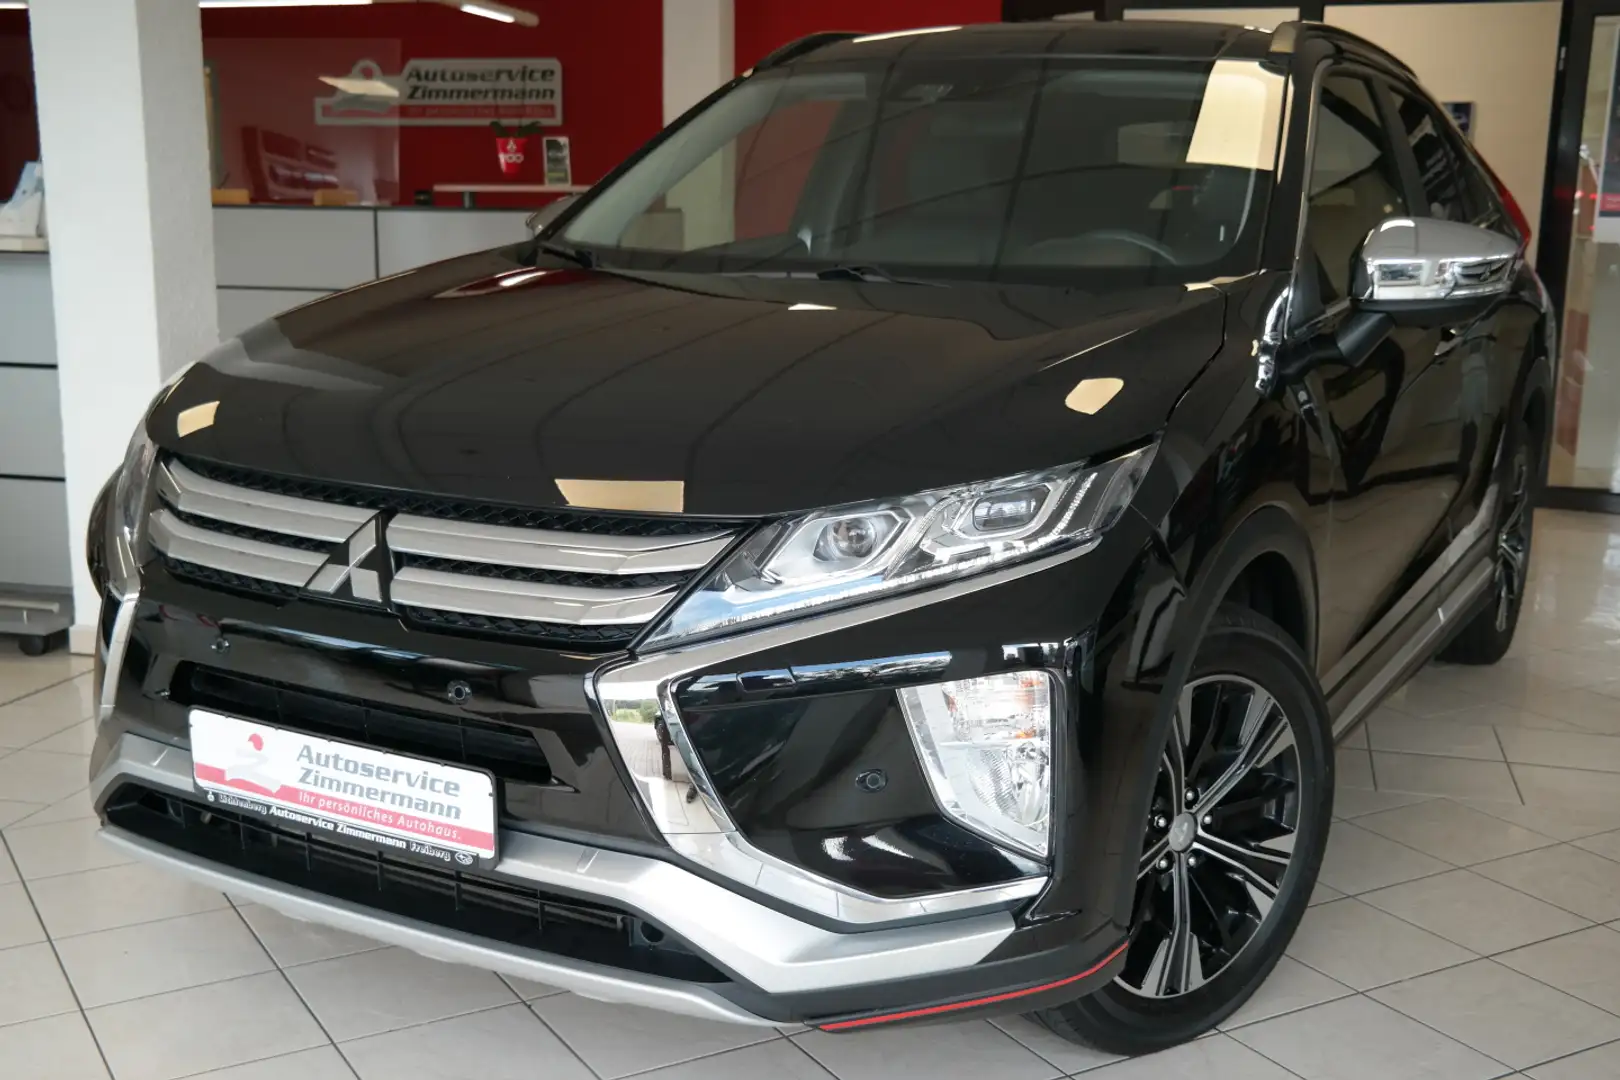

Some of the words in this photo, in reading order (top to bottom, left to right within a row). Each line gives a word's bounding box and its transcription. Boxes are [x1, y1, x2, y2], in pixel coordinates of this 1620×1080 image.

[406, 65, 556, 82] Autoservice
[407, 85, 556, 100] Zimmermann
[296, 744, 460, 797] Autoservice
[297, 767, 462, 820] Zimmermann
[269, 805, 334, 831] Autoservice
[336, 822, 406, 849] Zimmermann
[299, 792, 316, 804] Ihr
[318, 794, 393, 824] persönliches
[398, 815, 461, 840] Autohaus.
